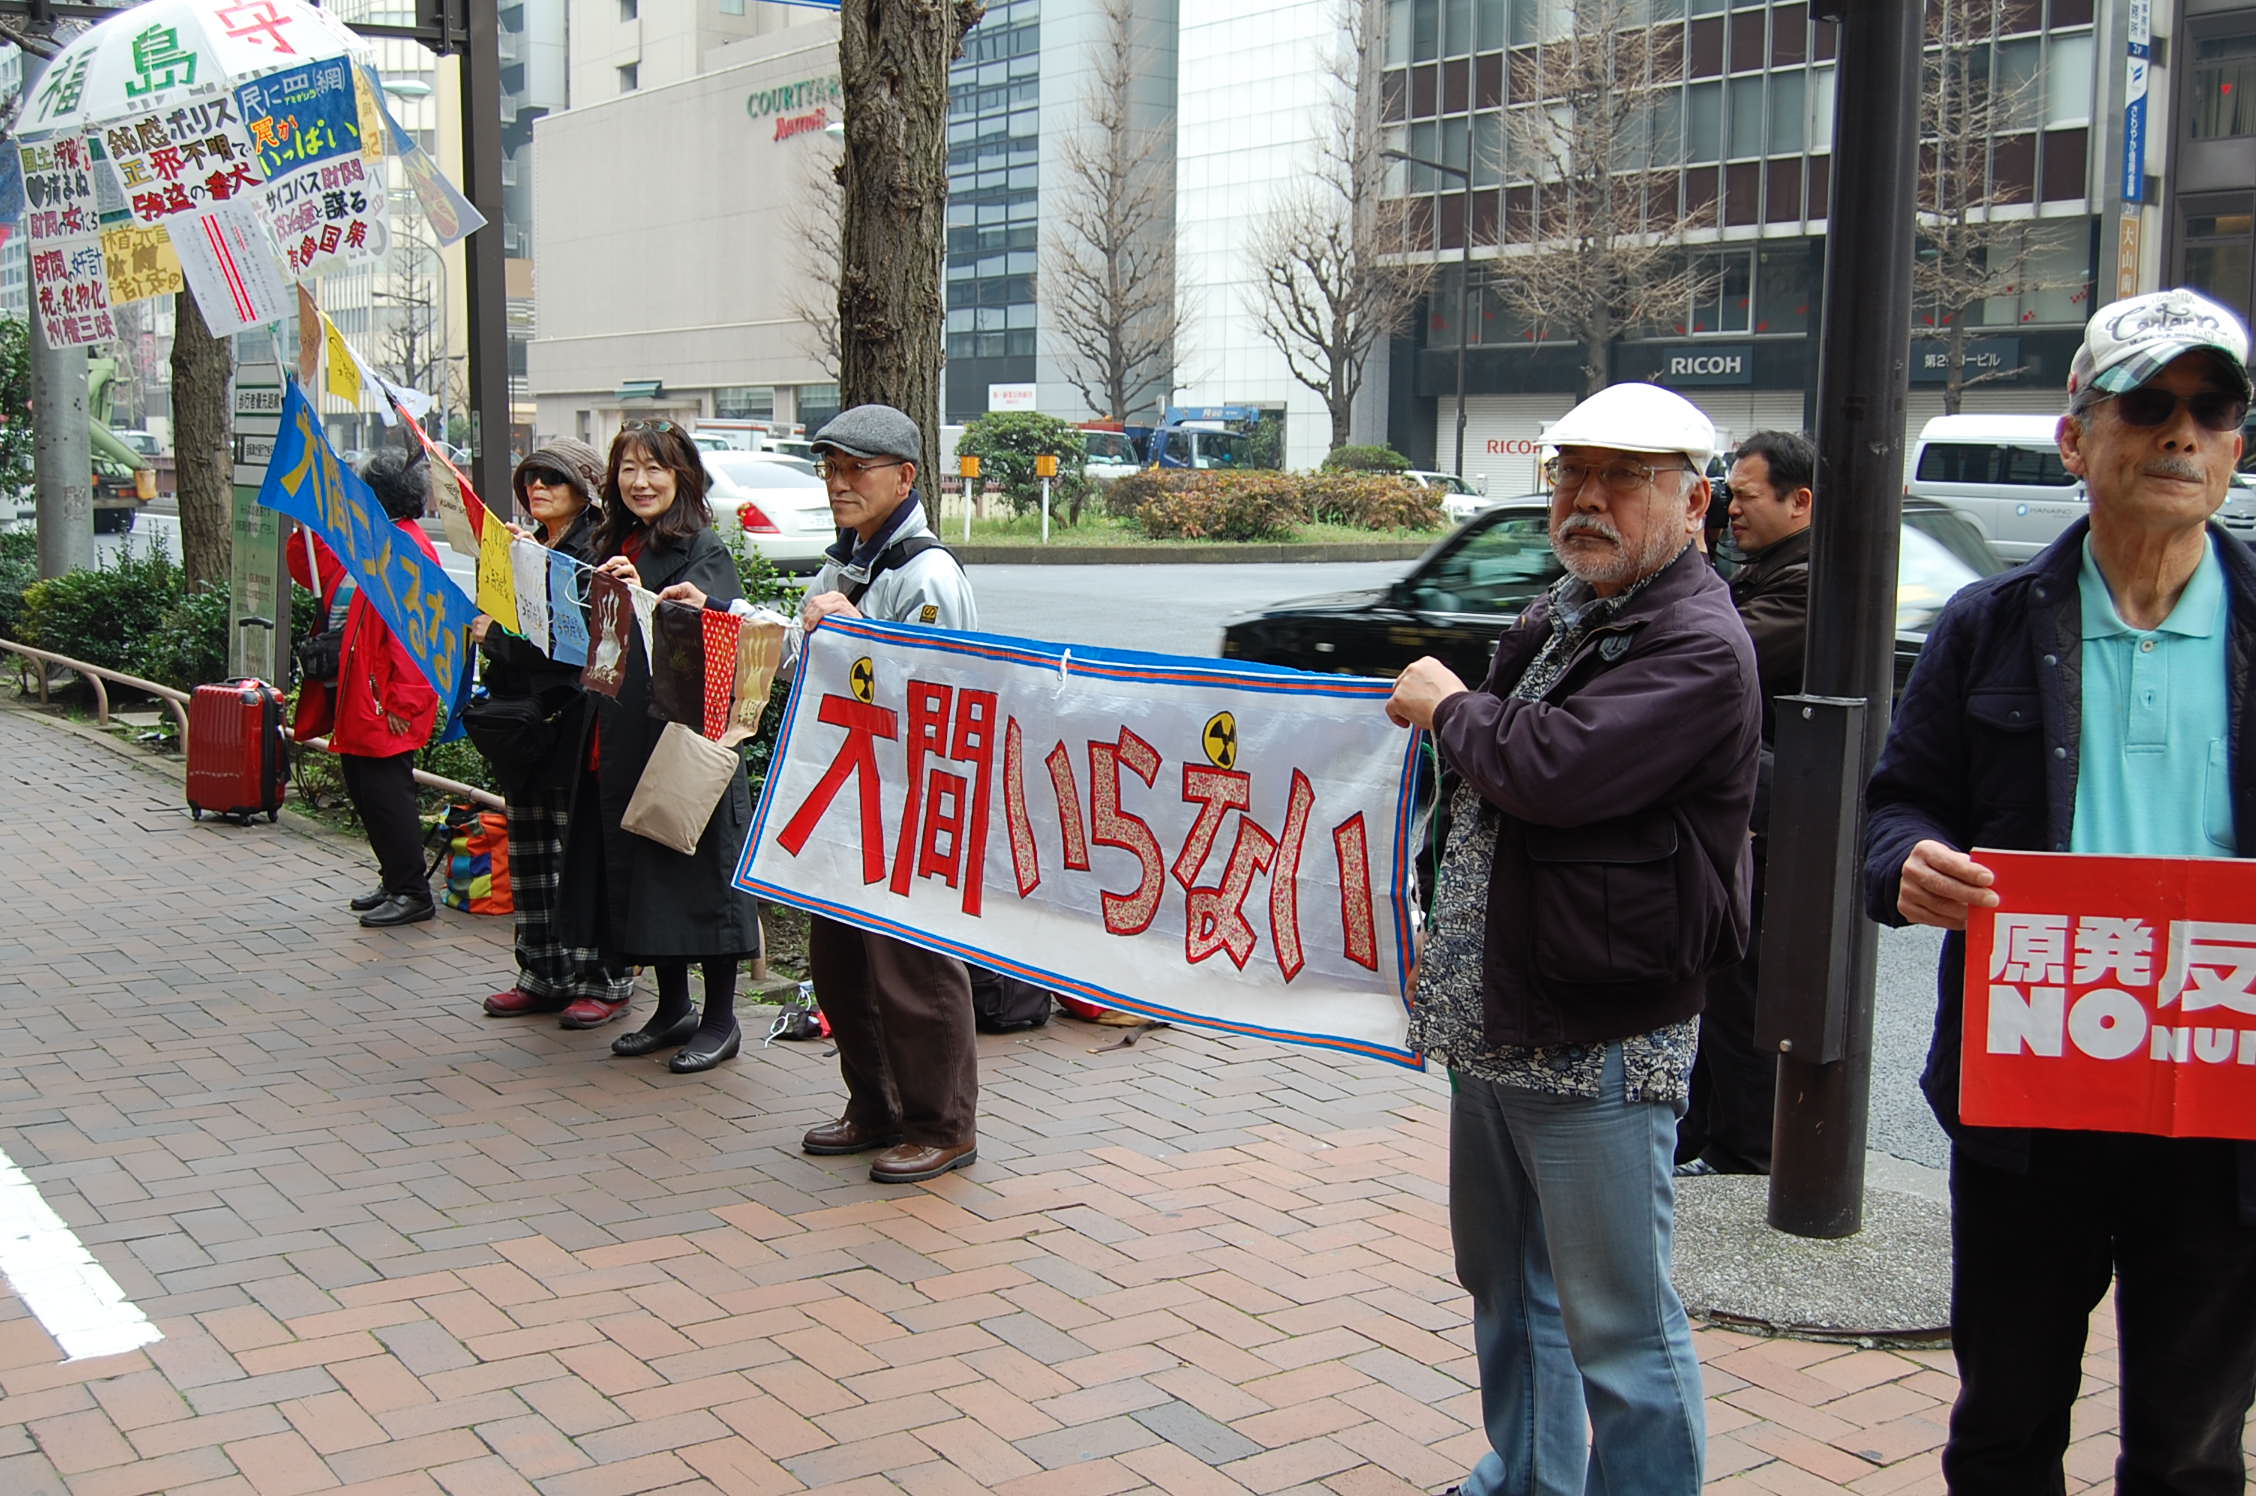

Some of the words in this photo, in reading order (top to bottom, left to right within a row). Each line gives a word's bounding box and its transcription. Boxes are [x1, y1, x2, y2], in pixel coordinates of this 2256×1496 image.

[1671, 357, 1741, 374] RICOH
[777, 680, 1378, 984] 大間いらない
[1986, 984, 2147, 1060] NO
